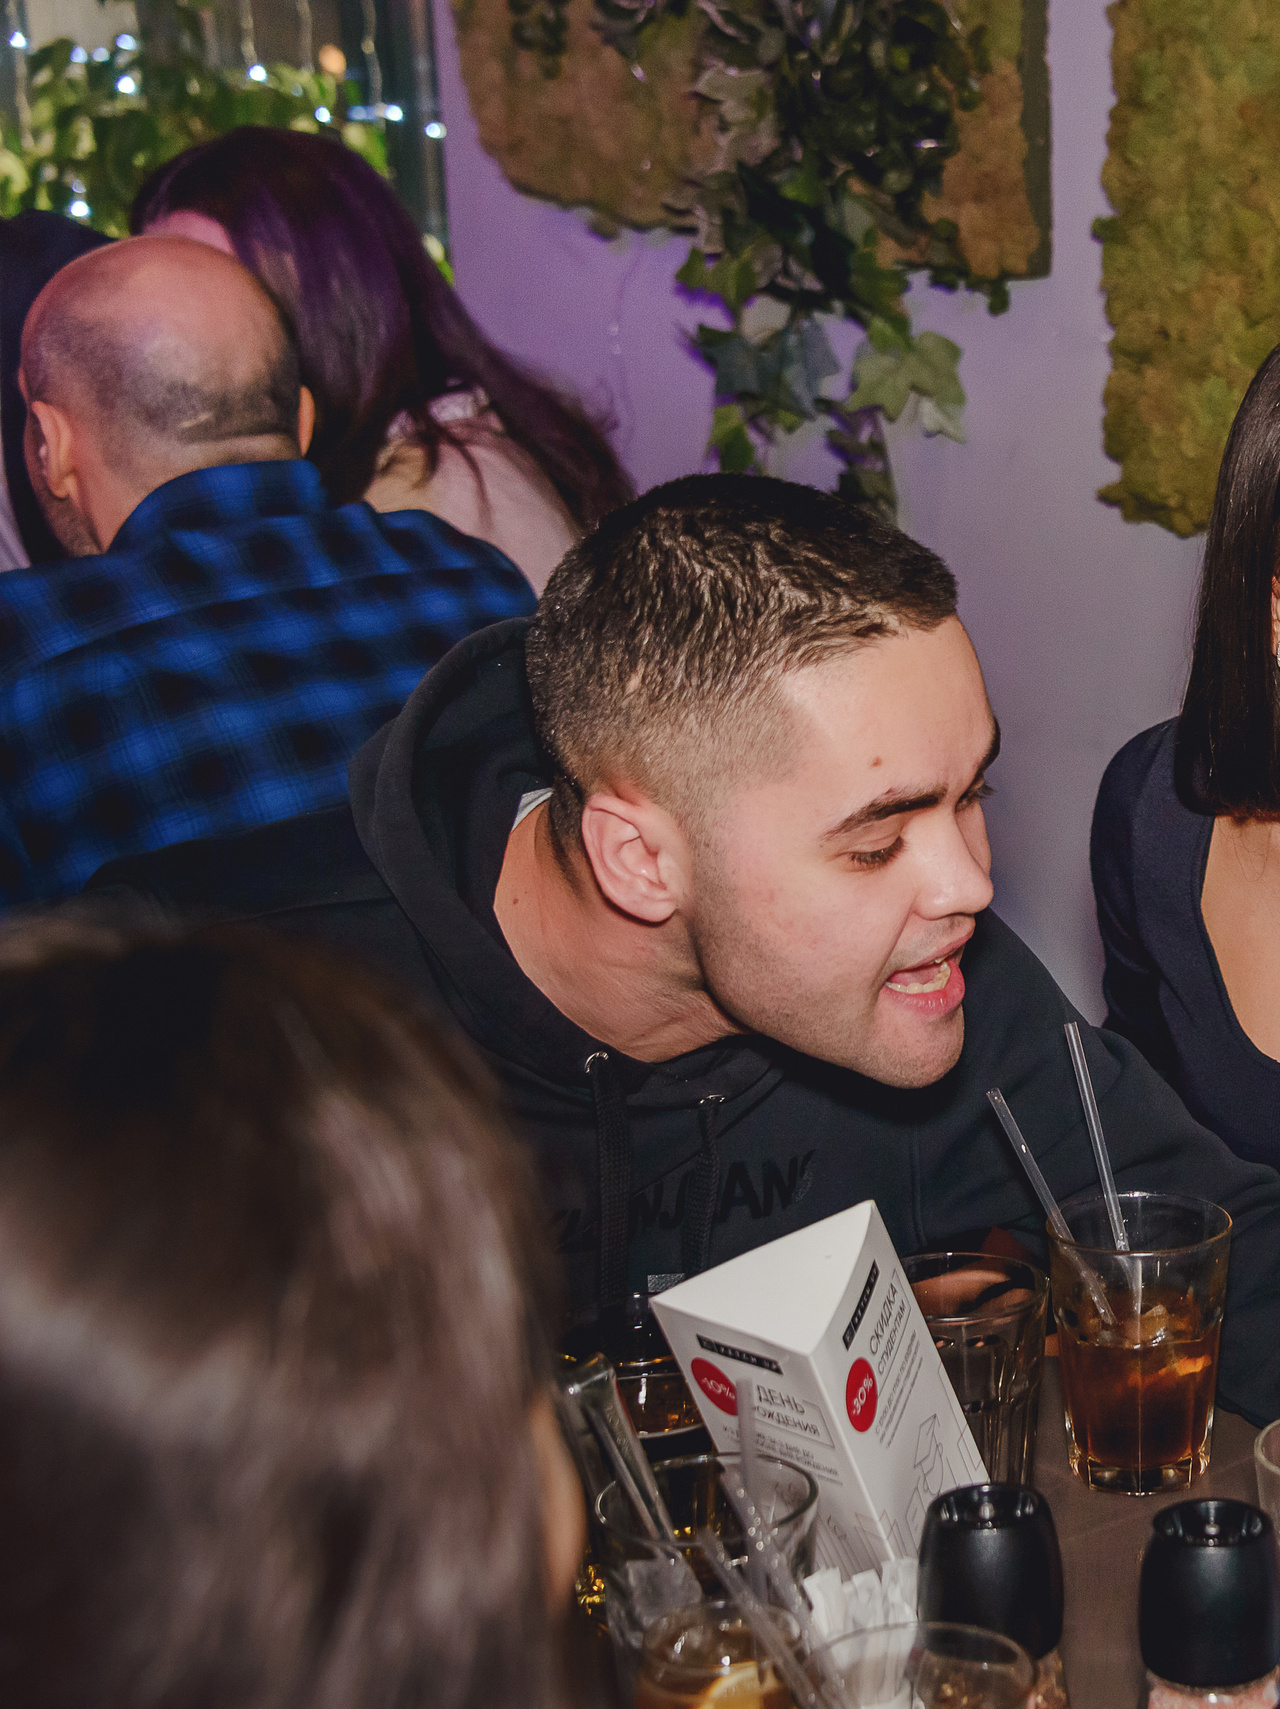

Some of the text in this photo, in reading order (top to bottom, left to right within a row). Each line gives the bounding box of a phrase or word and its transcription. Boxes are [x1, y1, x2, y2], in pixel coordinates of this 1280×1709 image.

[869, 1283, 899, 1356] СКИДКА
[877, 1299, 906, 1375] СТУДЕНТАМ
[756, 1385, 805, 1415] ДЕНЬ
[852, 1374, 874, 1416] -30%
